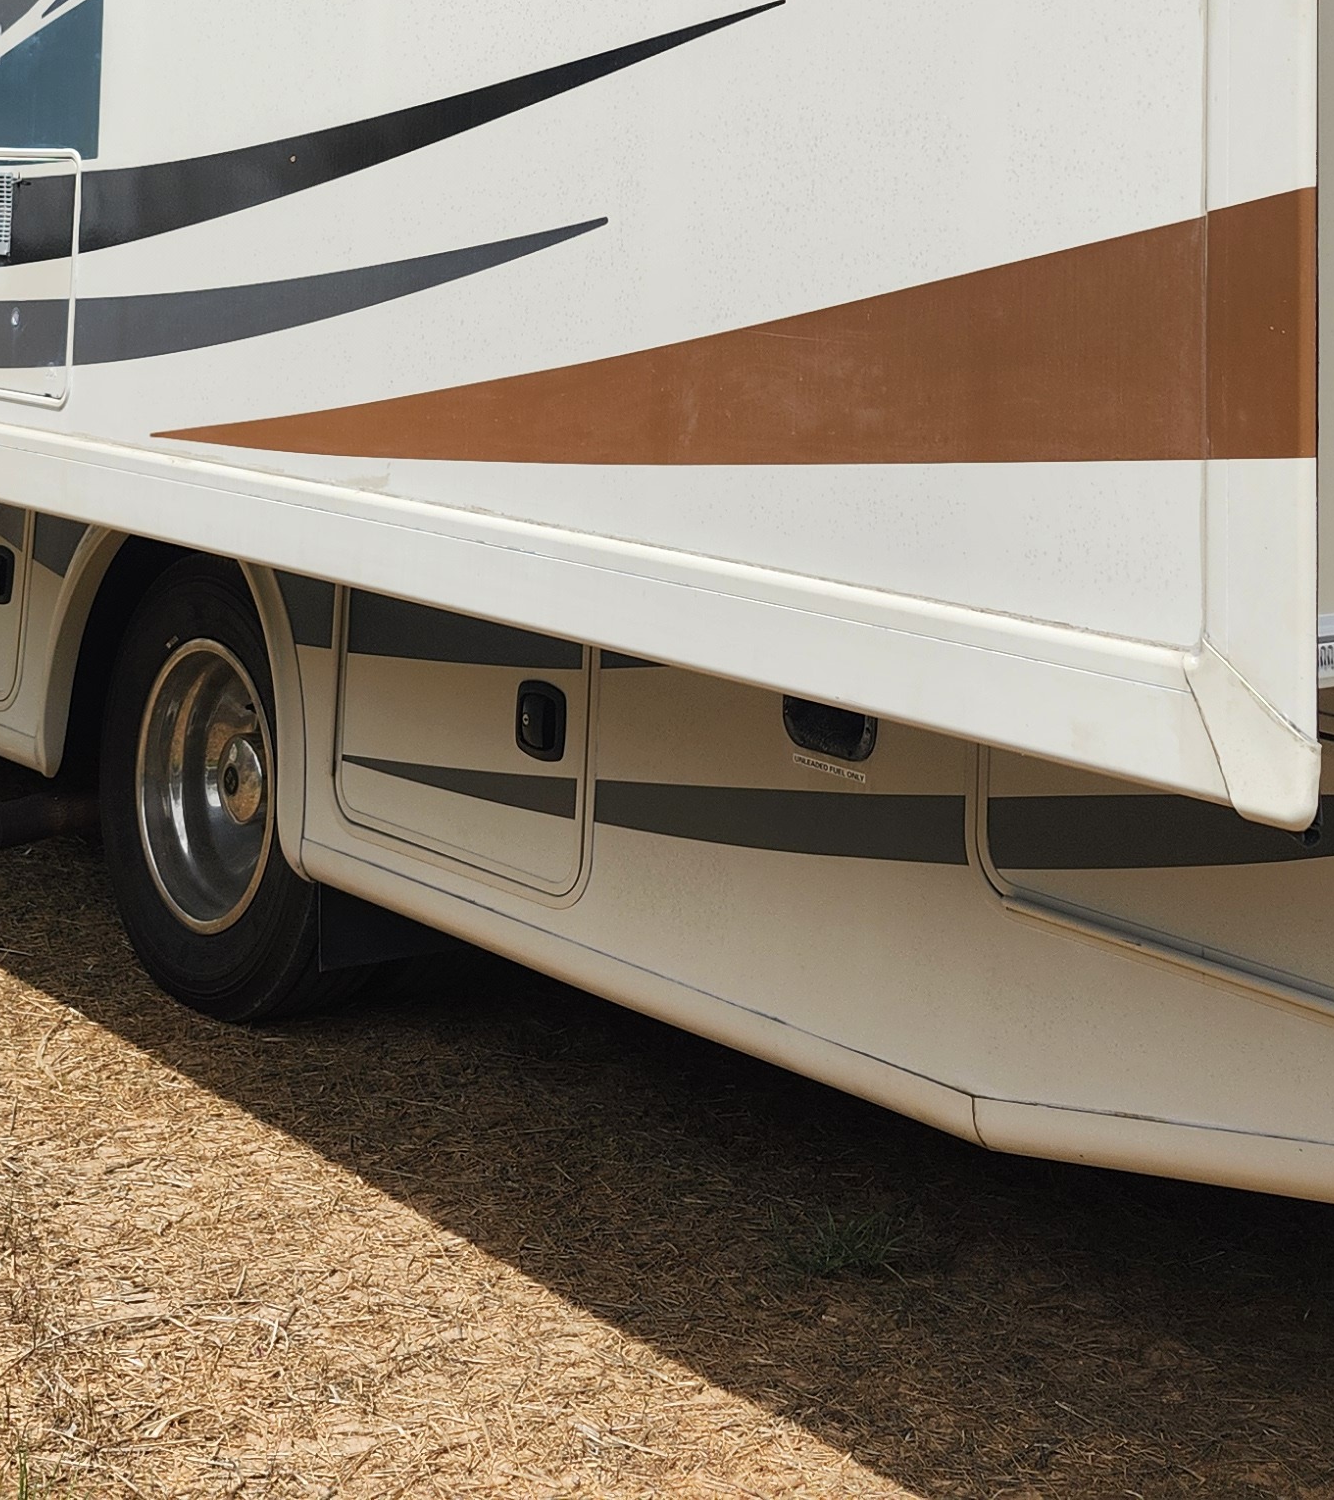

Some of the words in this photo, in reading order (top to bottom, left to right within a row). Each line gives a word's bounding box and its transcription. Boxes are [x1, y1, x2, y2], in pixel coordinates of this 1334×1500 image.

[794, 755, 828, 771] UNLEADED
[829, 766, 845, 777] FUEL
[847, 771, 865, 782] ONLY
